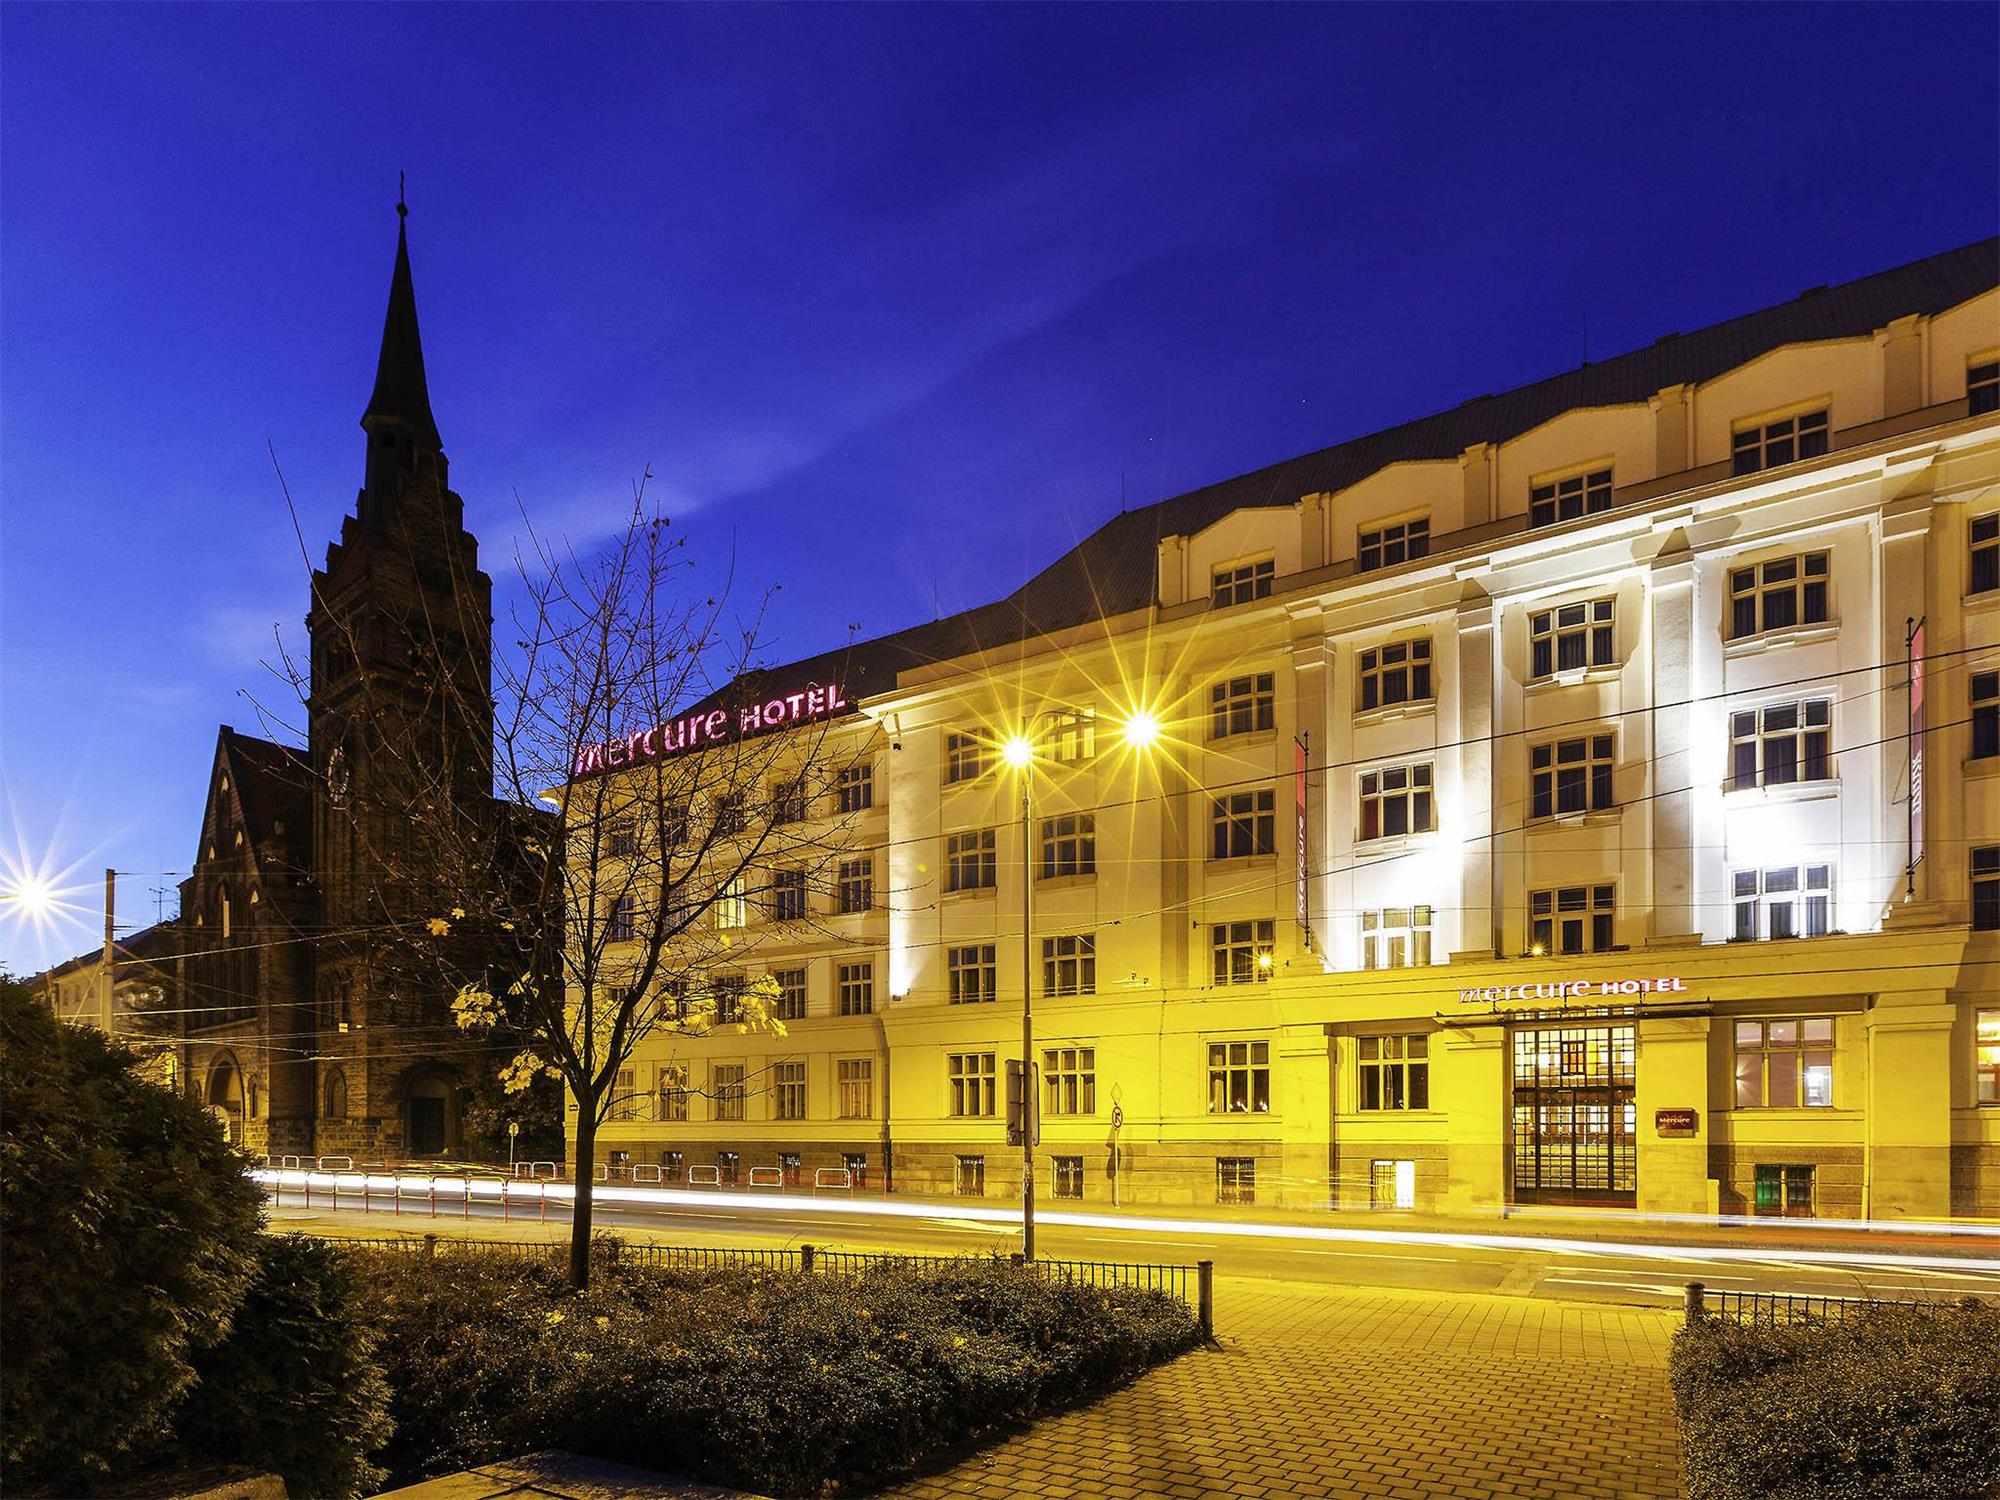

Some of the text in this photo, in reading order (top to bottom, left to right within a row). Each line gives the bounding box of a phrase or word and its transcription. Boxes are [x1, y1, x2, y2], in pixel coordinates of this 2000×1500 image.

[574, 684, 847, 775] mercure HOTEL
[1457, 977, 1688, 1004] mercure HOTEL
